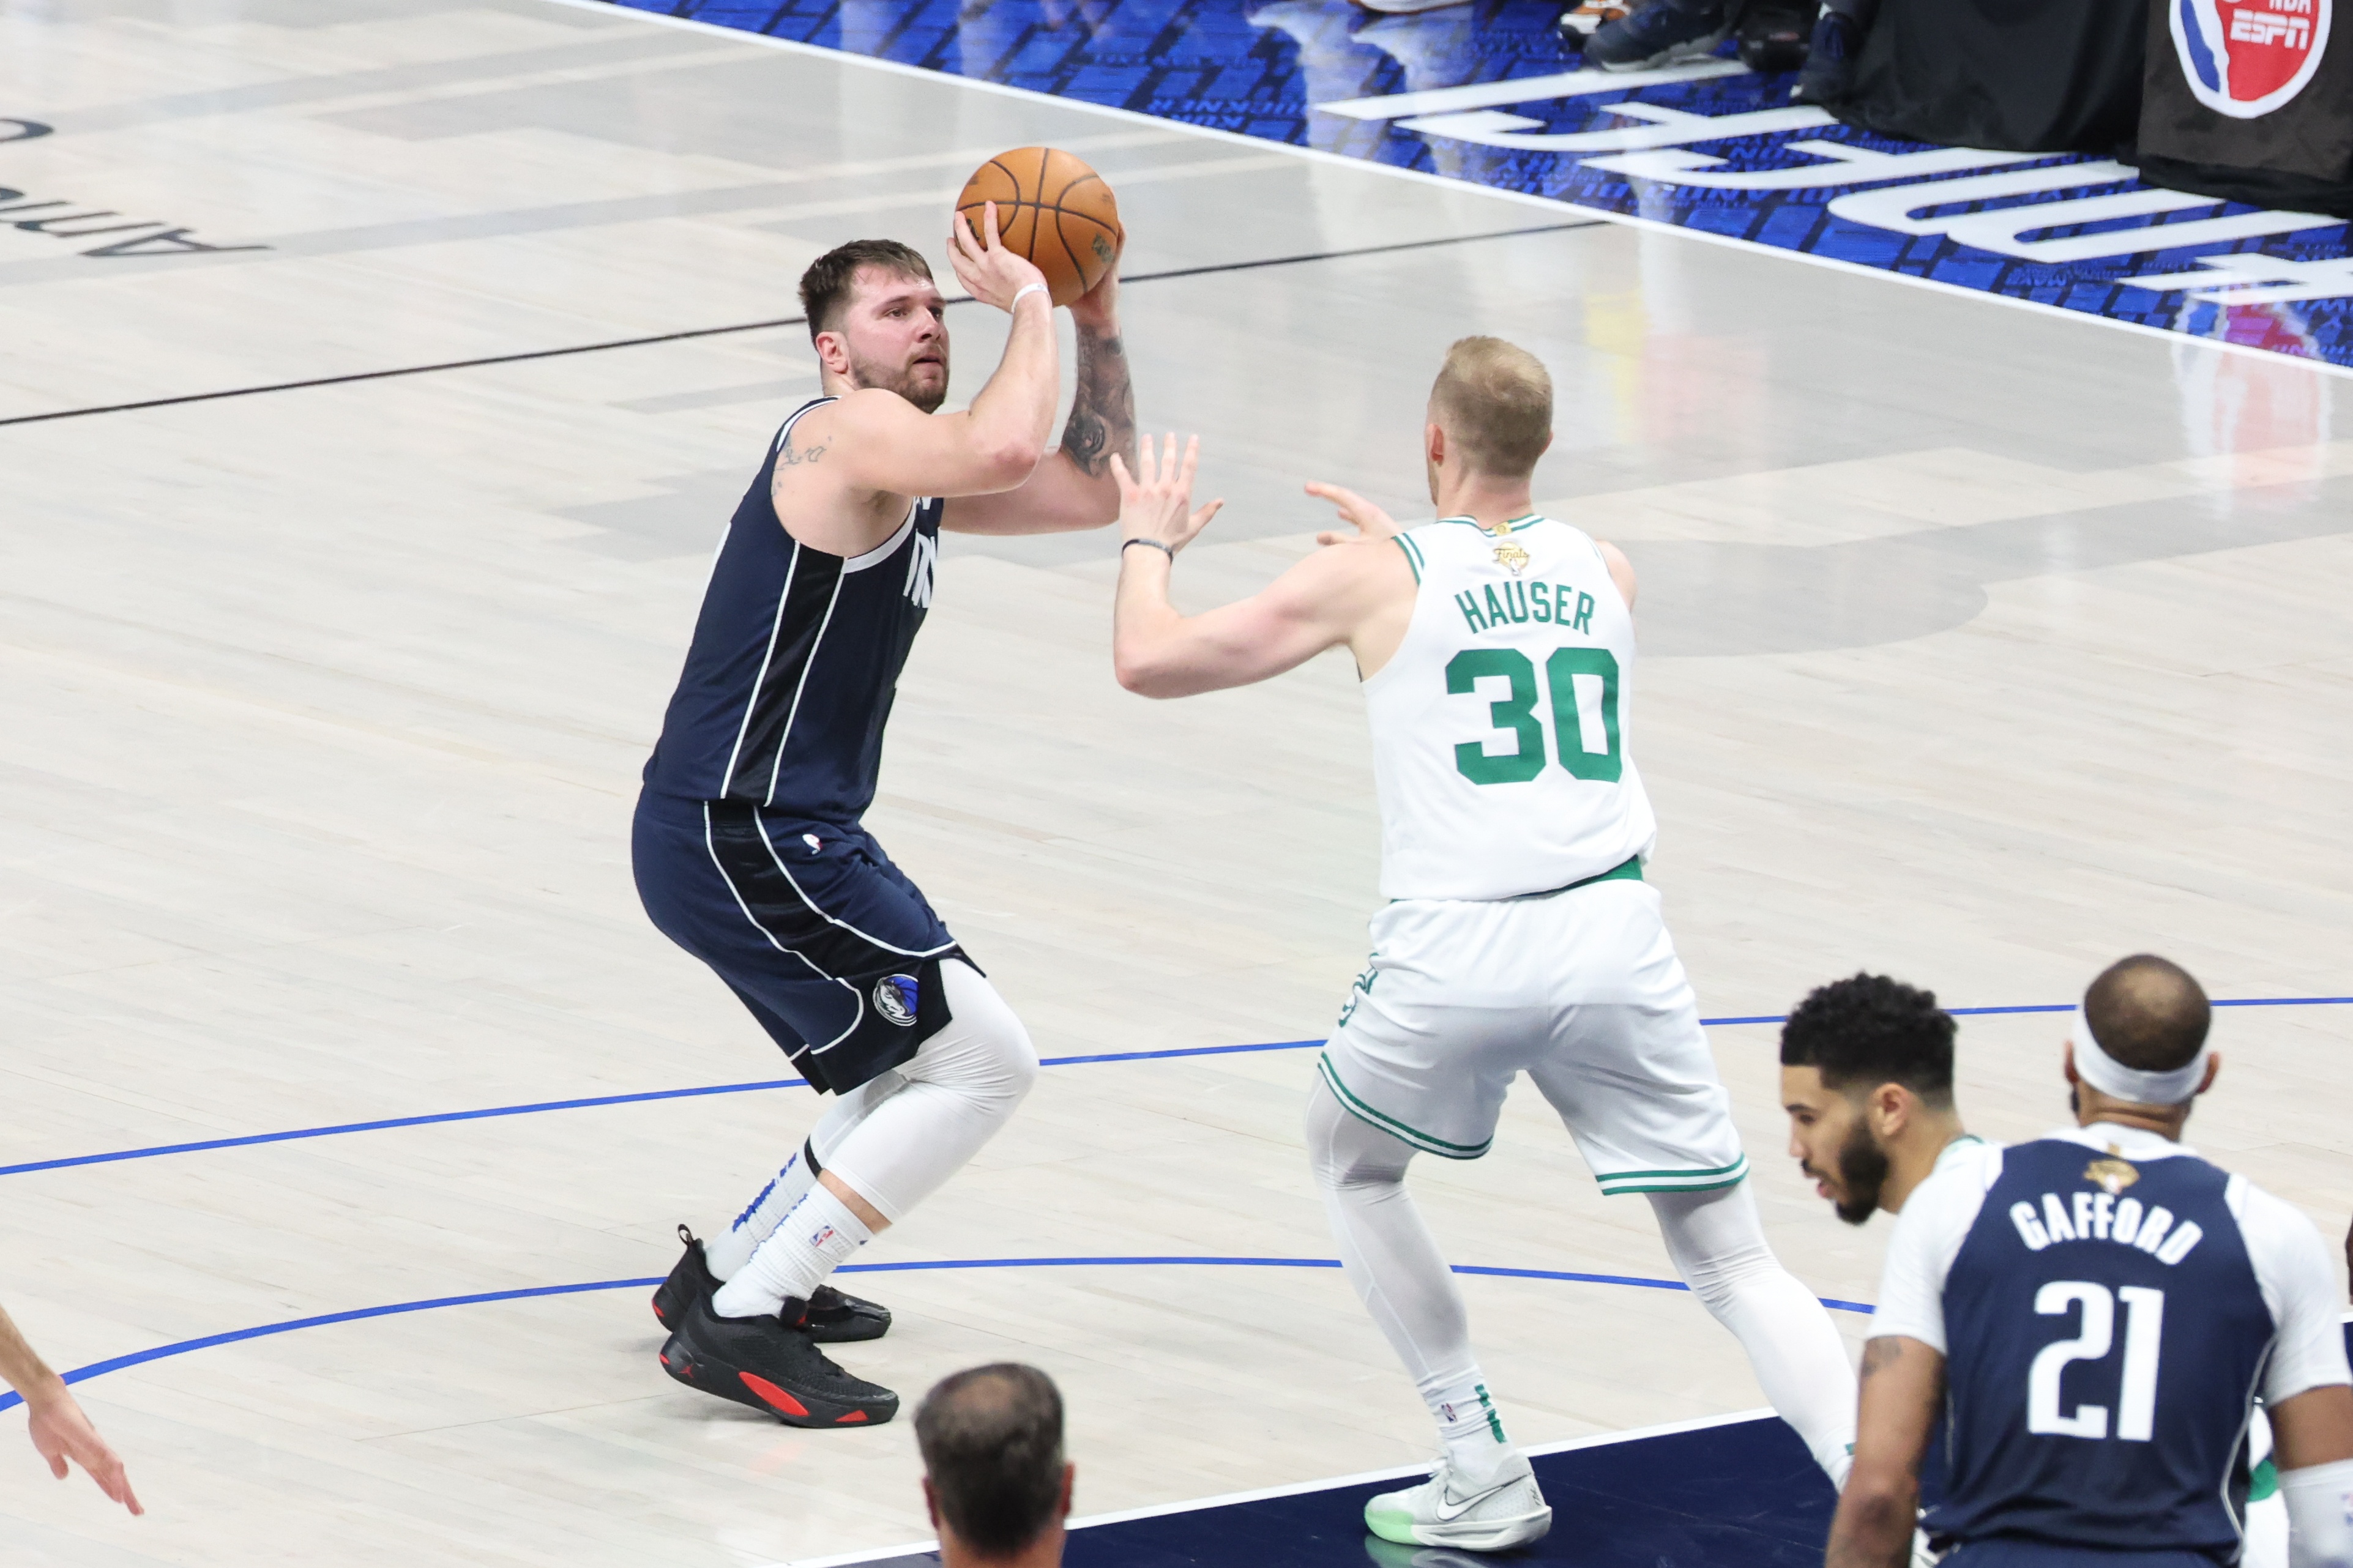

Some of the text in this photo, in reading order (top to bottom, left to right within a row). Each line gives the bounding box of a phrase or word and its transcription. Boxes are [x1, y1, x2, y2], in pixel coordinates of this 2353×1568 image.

[2230, 9, 2310, 50] ESPN
[1454, 581, 1595, 635] HAUSER
[1445, 647, 1623, 786] 30
[2010, 1191, 2204, 1265] GAFFORD
[2027, 1280, 2165, 1442] 21
